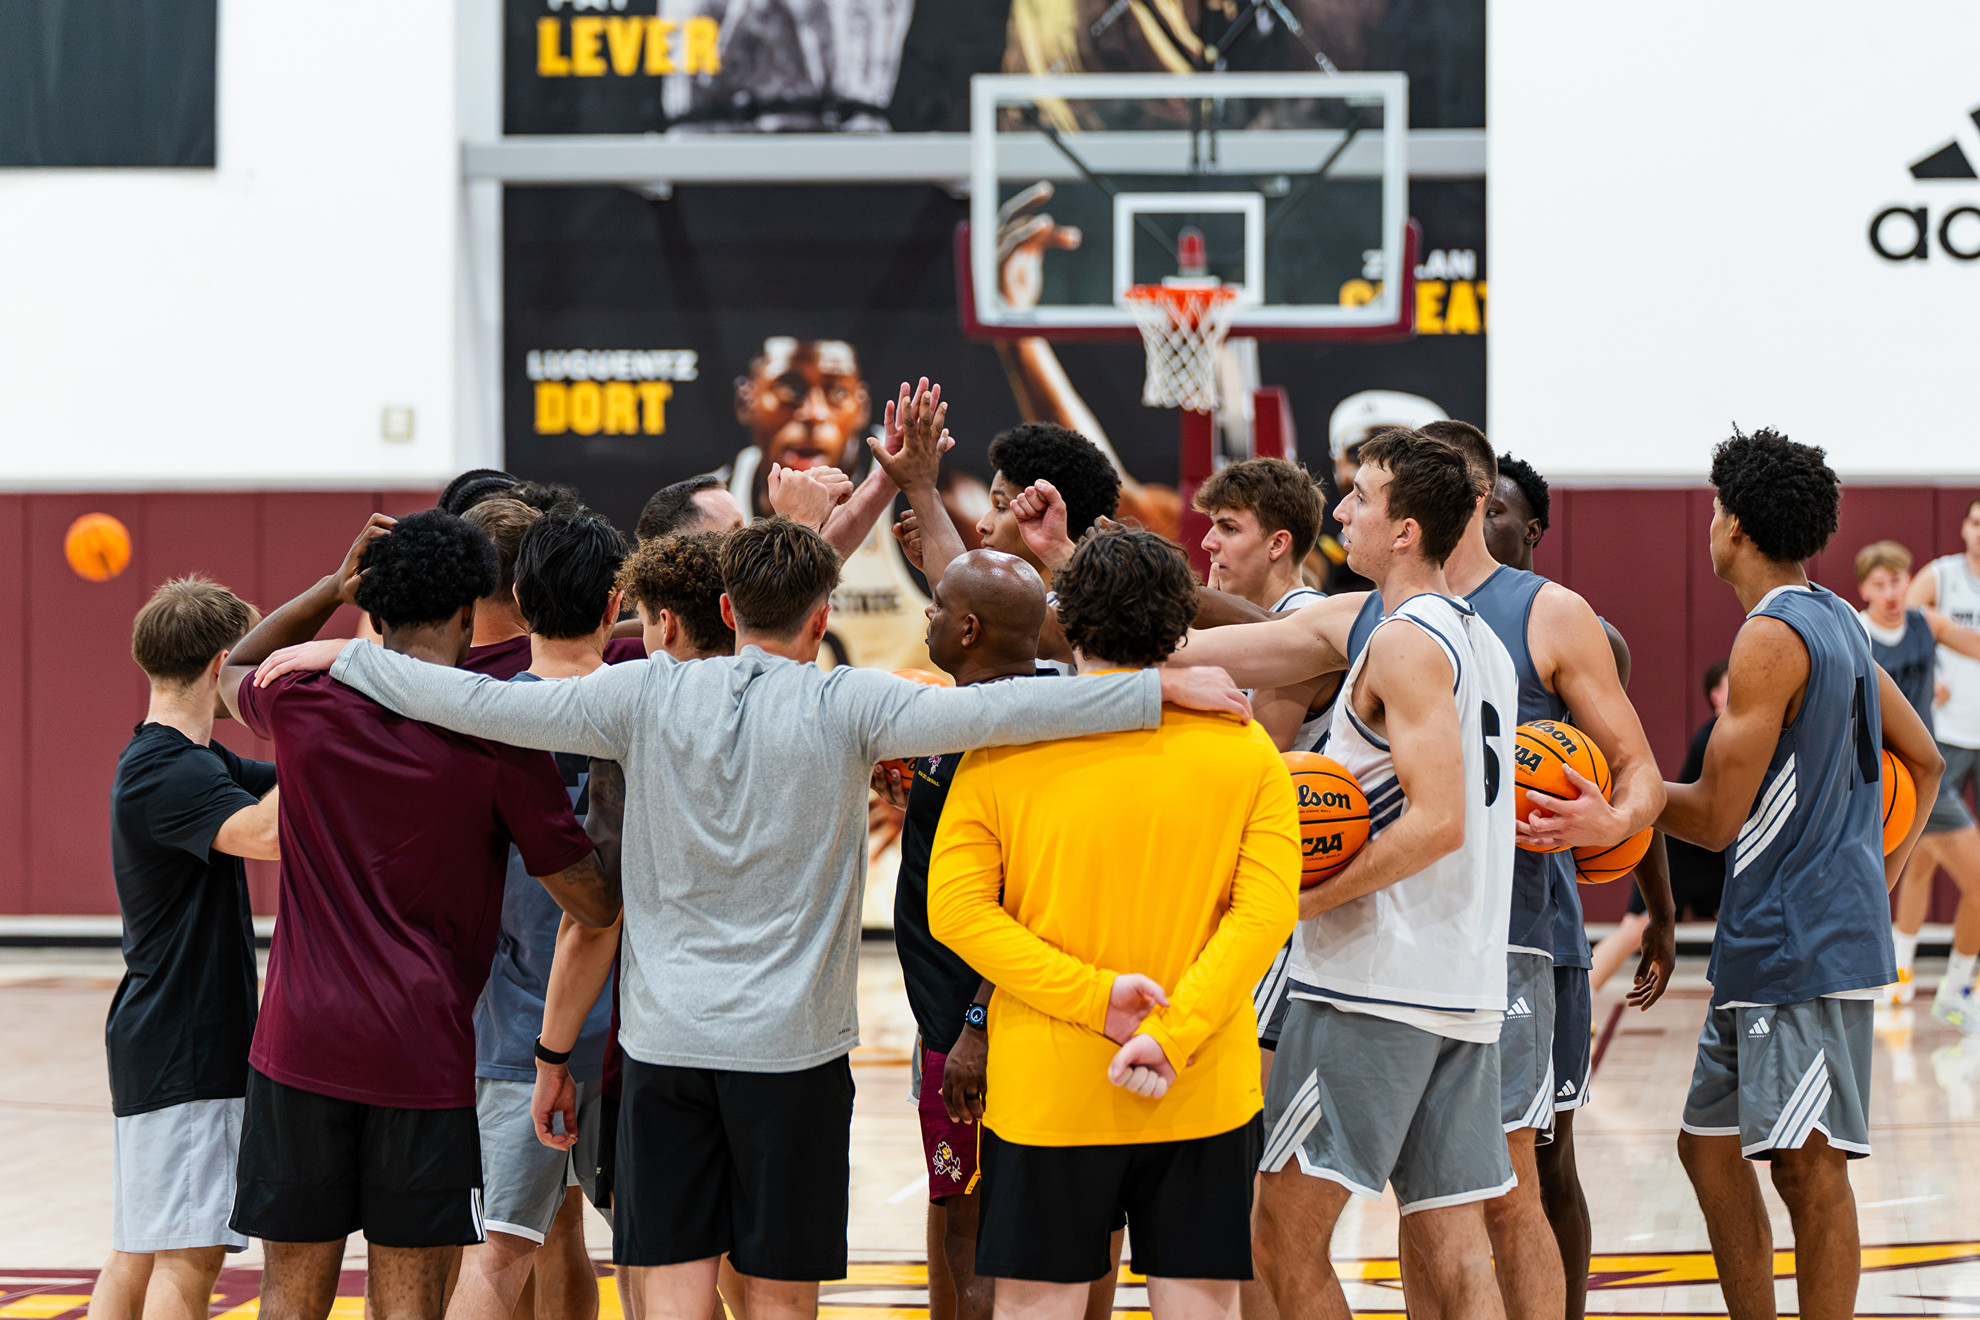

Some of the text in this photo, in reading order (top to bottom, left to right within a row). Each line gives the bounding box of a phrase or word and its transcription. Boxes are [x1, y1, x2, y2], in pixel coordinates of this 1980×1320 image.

[536, 16, 721, 77] LEVER
[534, 379, 673, 436] DORT
[1301, 832, 1342, 856] CAA
